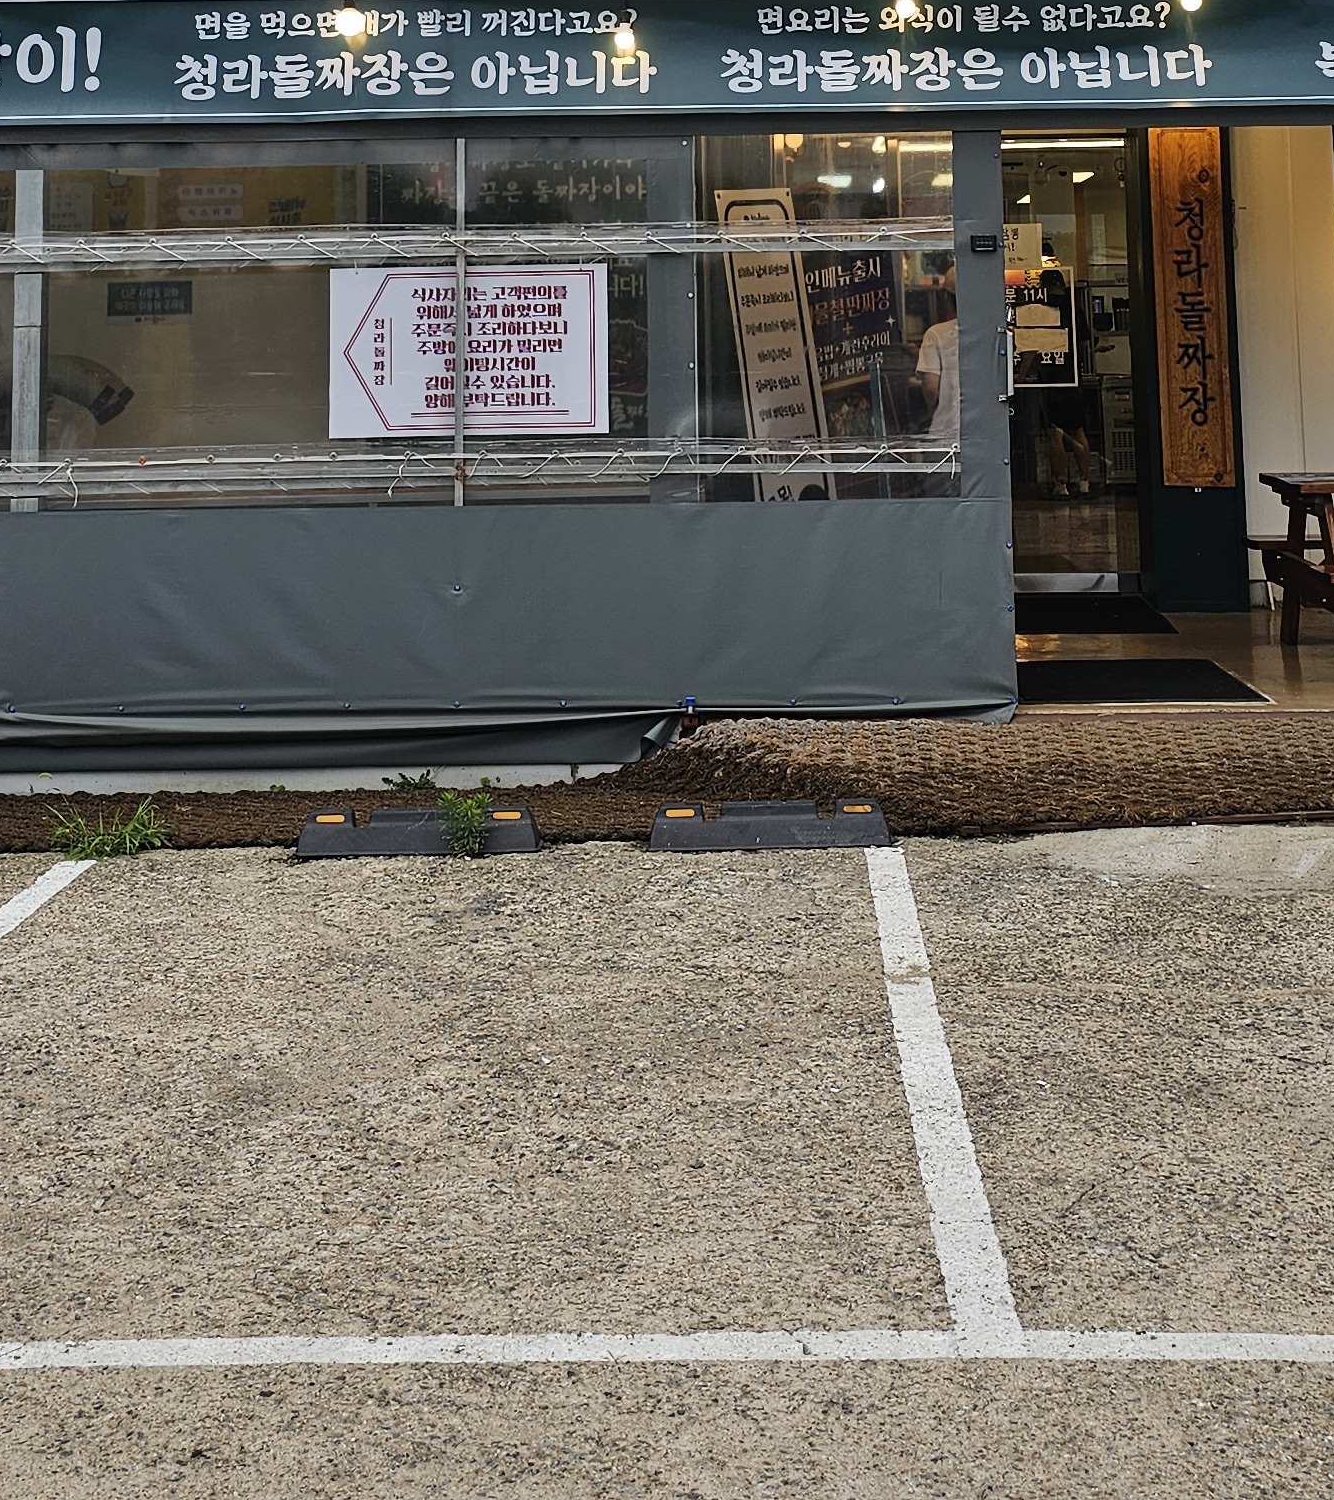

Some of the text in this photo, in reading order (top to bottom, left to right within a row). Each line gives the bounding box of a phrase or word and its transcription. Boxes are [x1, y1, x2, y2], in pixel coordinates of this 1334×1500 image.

[194, 9, 250, 41] 면을
[259, 9, 346, 40] 먹으면
[416, 8, 471, 38] 빨리
[481, 7, 639, 36] 꺼진다고요?
[757, 2, 1171, 35] 면요리는 외식이 될수 없다고요?
[173, 49, 658, 101] 청라돌짜장은 아닙니다
[720, 43, 1213, 94] 청라돌짜장은 아닙니다
[532, 173, 647, 205] 돌짜장이야
[501, 302, 562, 319] 하였으며
[1023, 287, 1047, 303] 11시
[476, 319, 568, 336] 조리하다보니
[1173, 197, 1216, 427] 청라돌짜장
[373, 318, 385, 387] 청라돌짜장
[467, 339, 512, 354] 요리가
[516, 338, 563, 354] 밀리면
[490, 373, 556, 390] 있습니다.
[424, 391, 556, 409] 양해 부탁드립니다.
